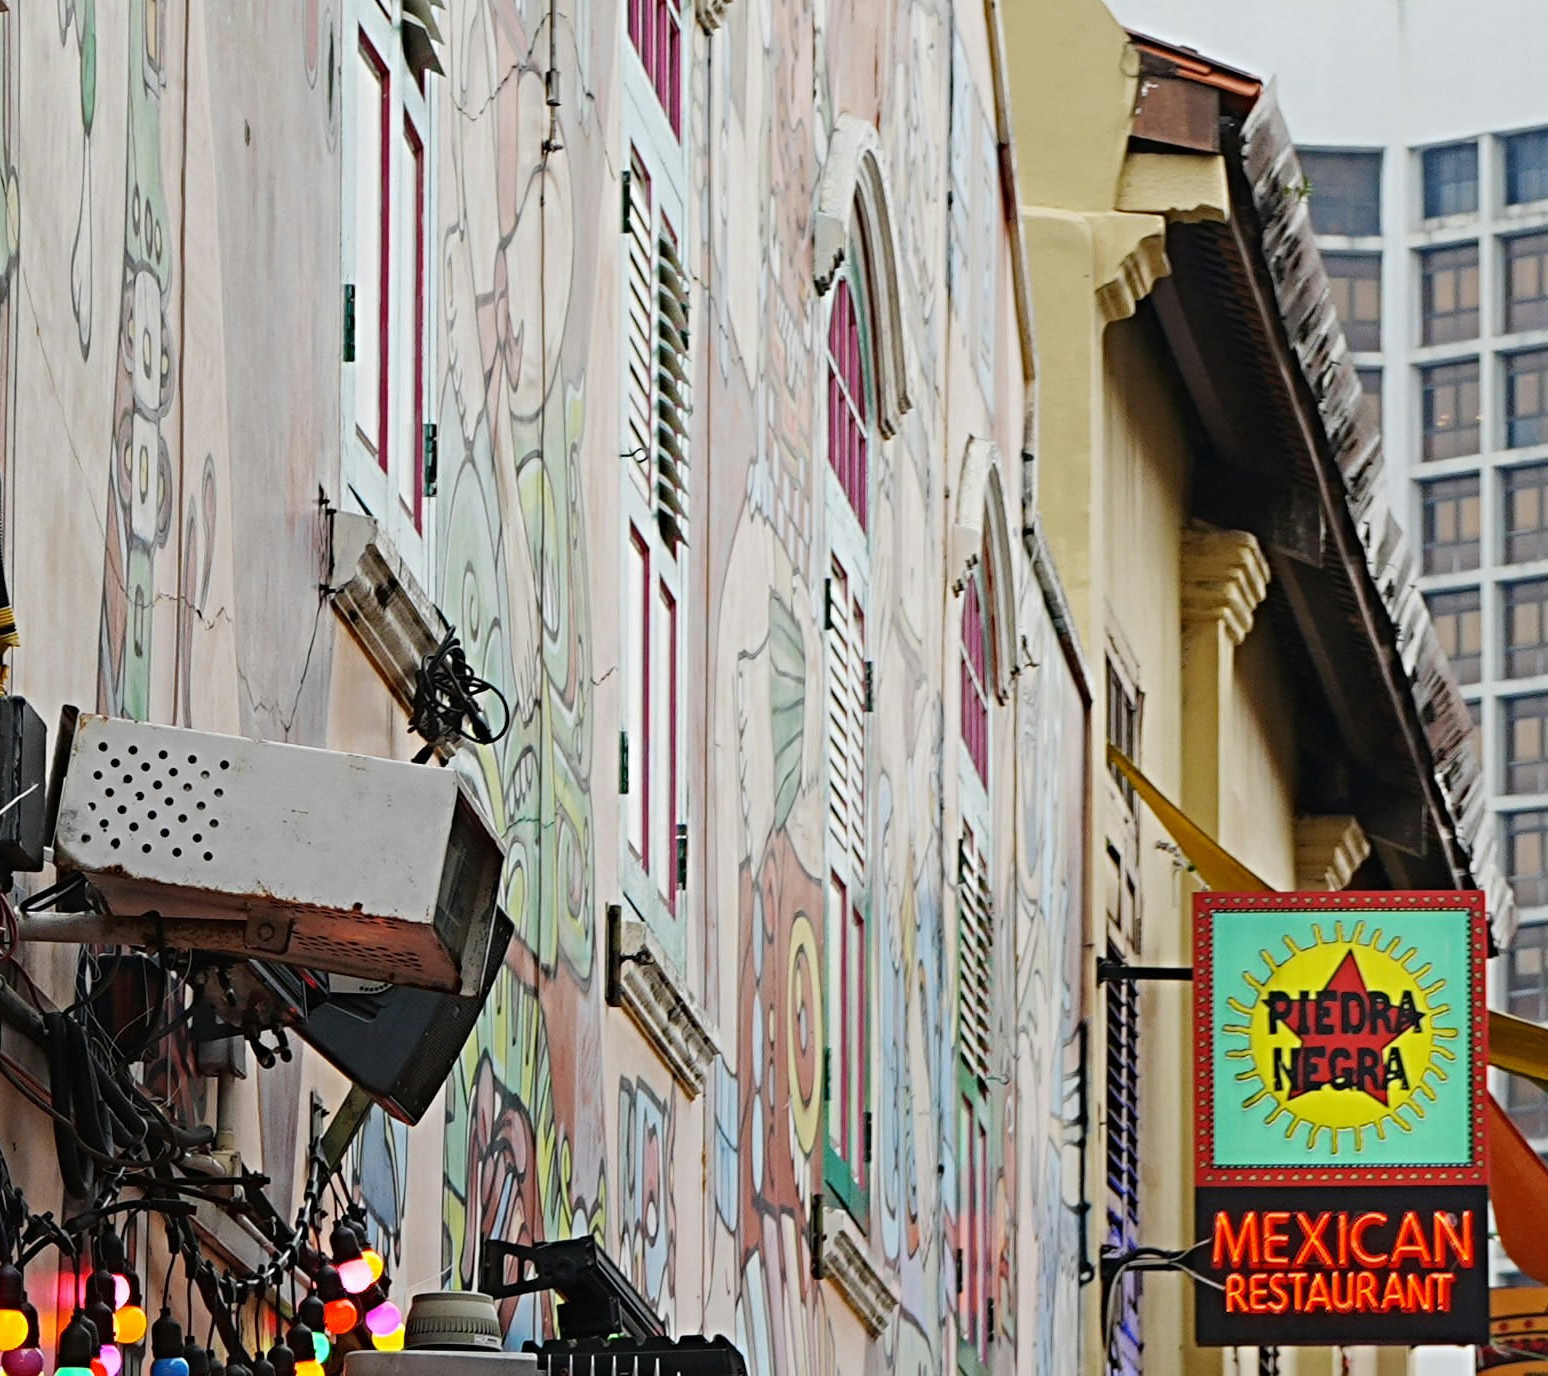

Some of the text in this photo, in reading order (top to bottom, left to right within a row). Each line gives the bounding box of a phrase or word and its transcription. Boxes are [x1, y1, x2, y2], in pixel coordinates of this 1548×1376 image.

[1264, 990, 1424, 1035] PIEDRA
[1273, 1047, 1410, 1091] NEGRA
[1212, 1211, 1474, 1268] MEXICAN
[1226, 1271, 1455, 1313] RESTAURANT
